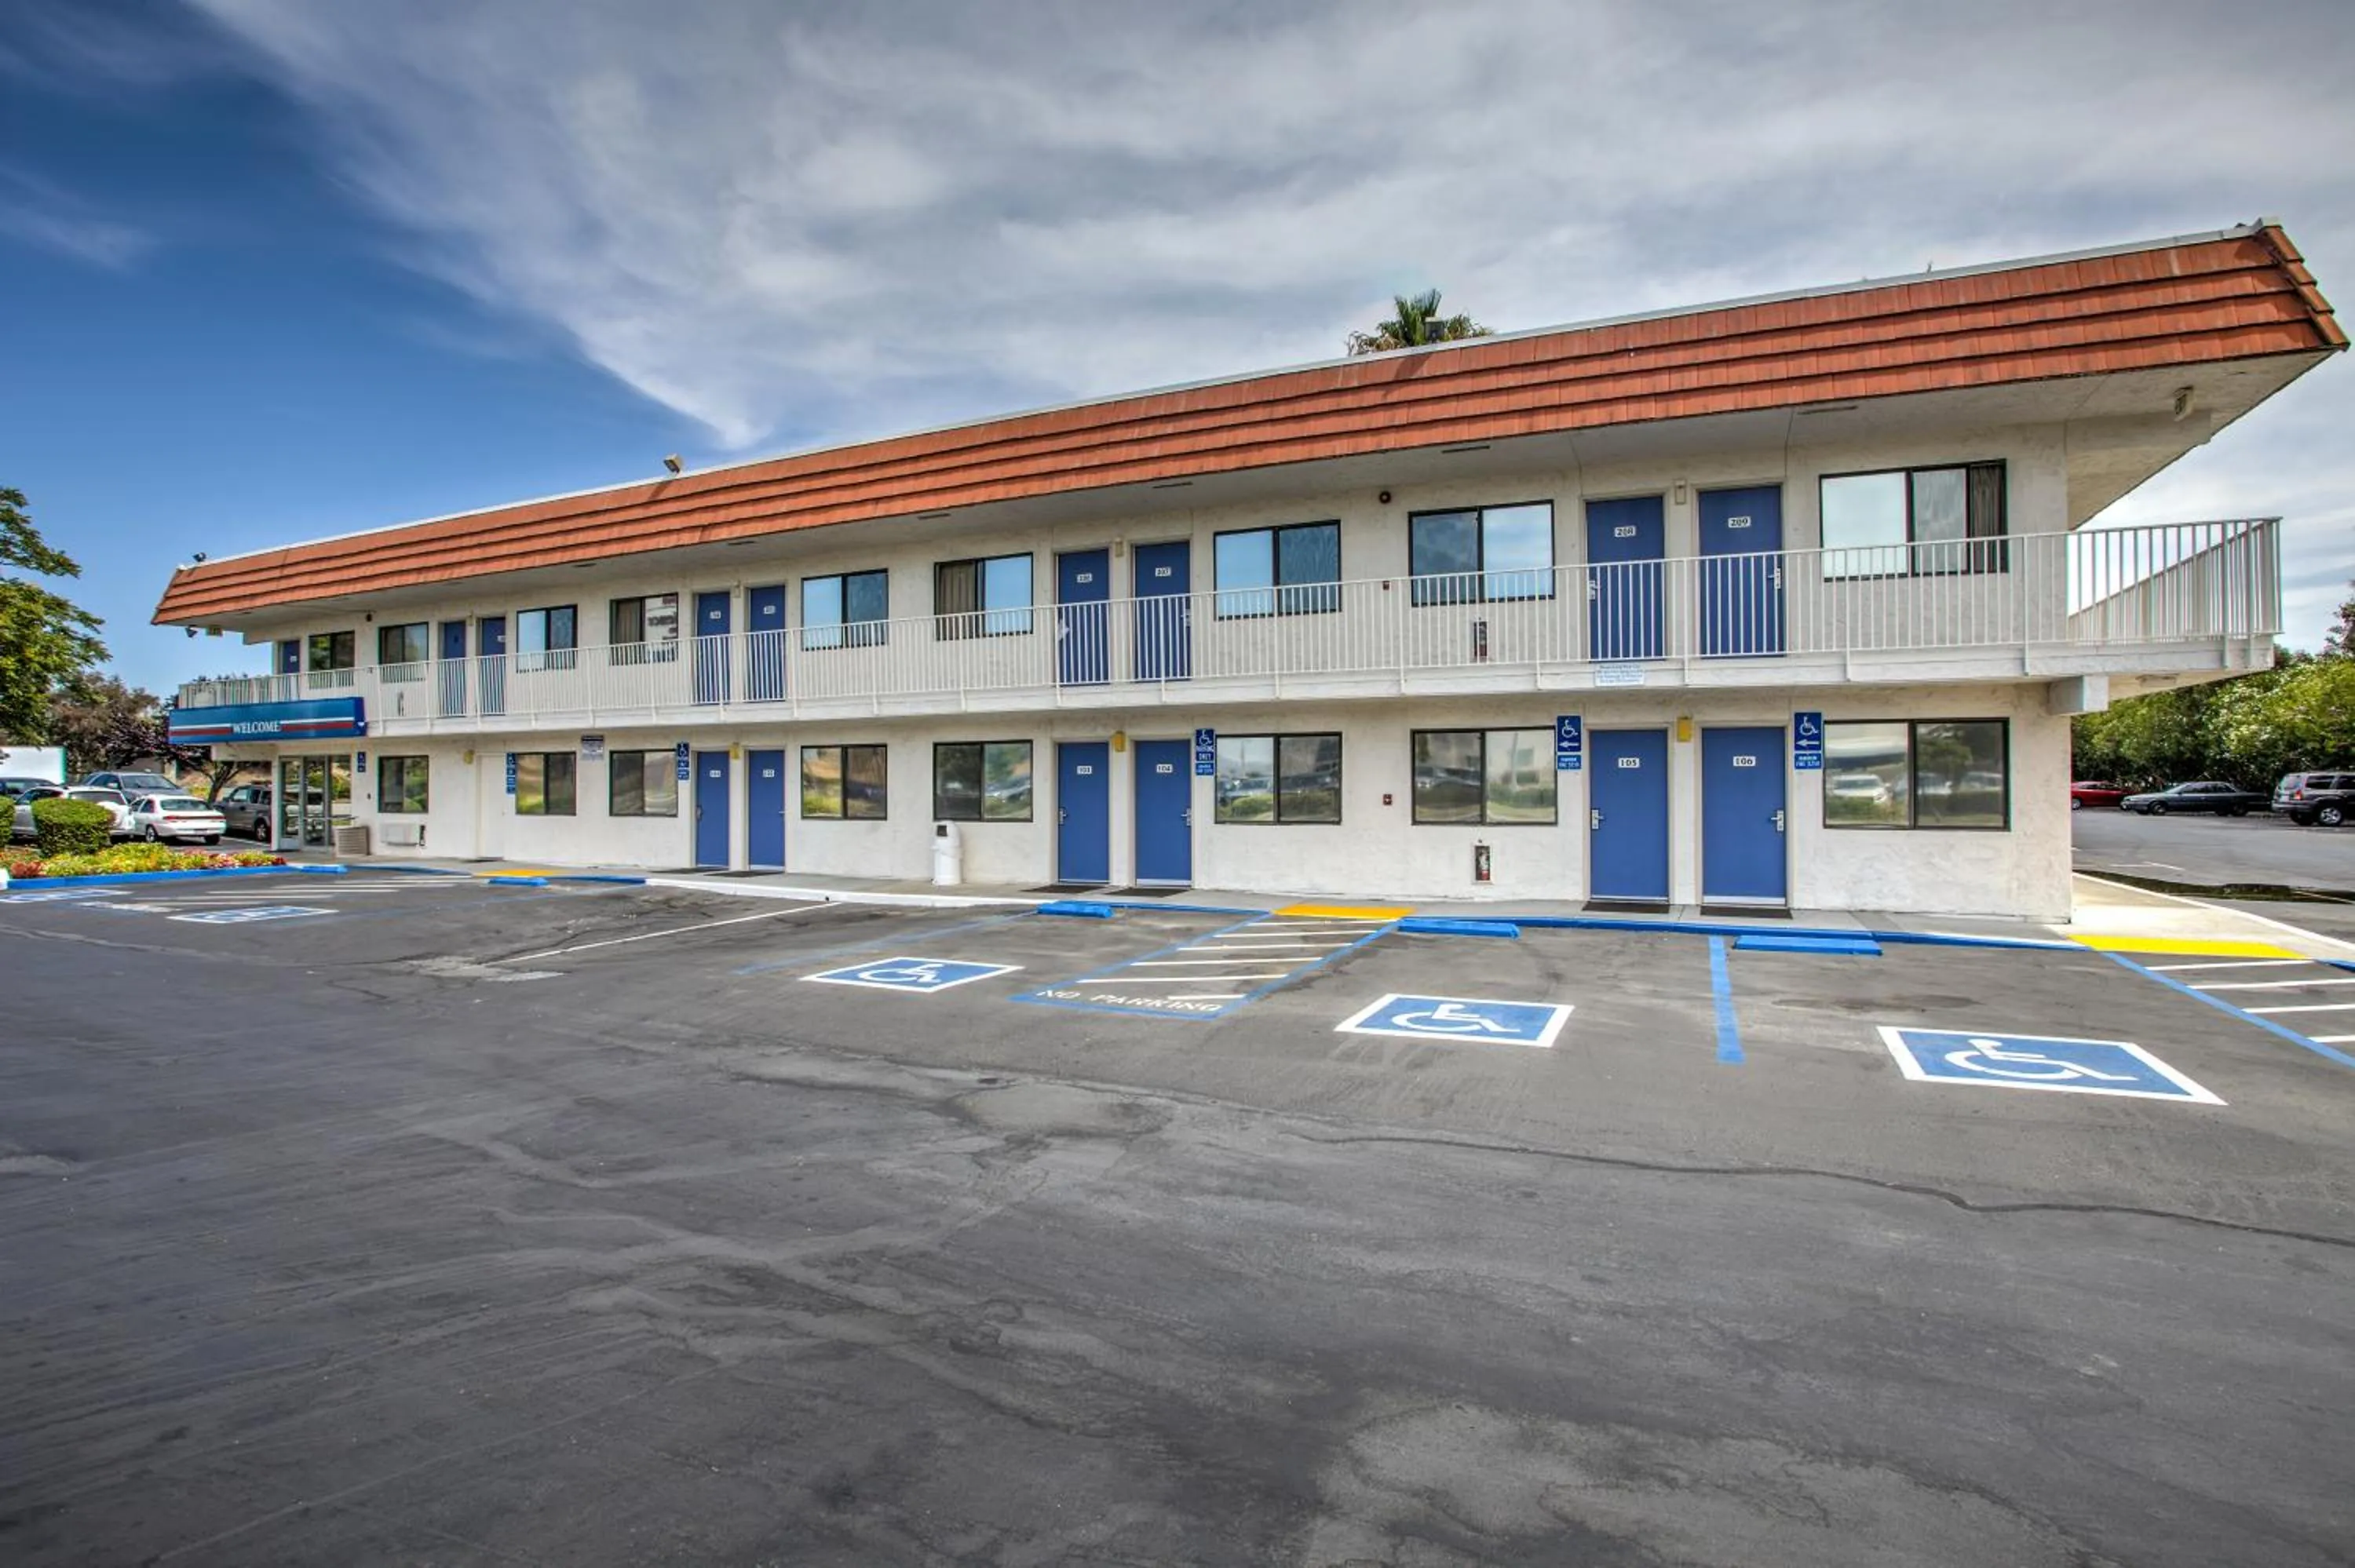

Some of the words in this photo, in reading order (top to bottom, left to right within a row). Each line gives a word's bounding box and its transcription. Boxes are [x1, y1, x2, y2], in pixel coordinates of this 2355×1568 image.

[1730, 517, 1749, 527] 209
[1616, 527, 1634, 537] 208
[233, 720, 280, 735] WELCOME
[1620, 758, 1637, 767] 105
[1736, 757, 1753, 765] 106
[1035, 990, 1080, 999] NO
[1090, 994, 1222, 1012] PARKING
